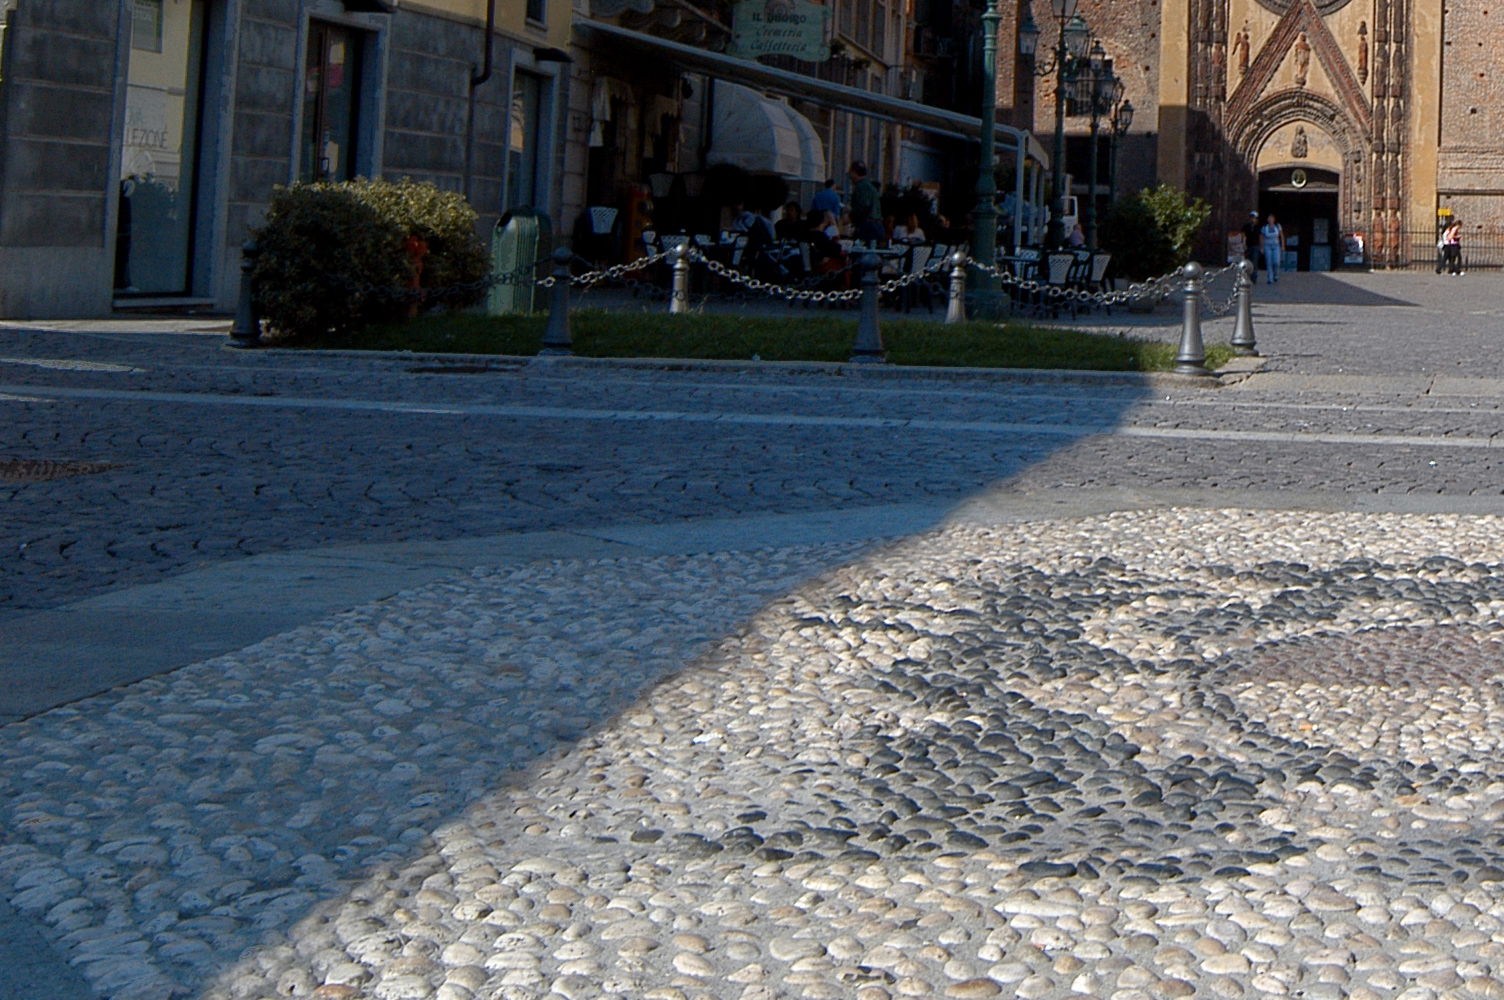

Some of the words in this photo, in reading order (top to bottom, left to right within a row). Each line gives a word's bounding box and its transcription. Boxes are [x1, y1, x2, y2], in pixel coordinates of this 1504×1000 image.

[752, 12, 763, 22] IL
[756, 25, 803, 38] Cremeria
[750, 39, 808, 53] Caffetteria
